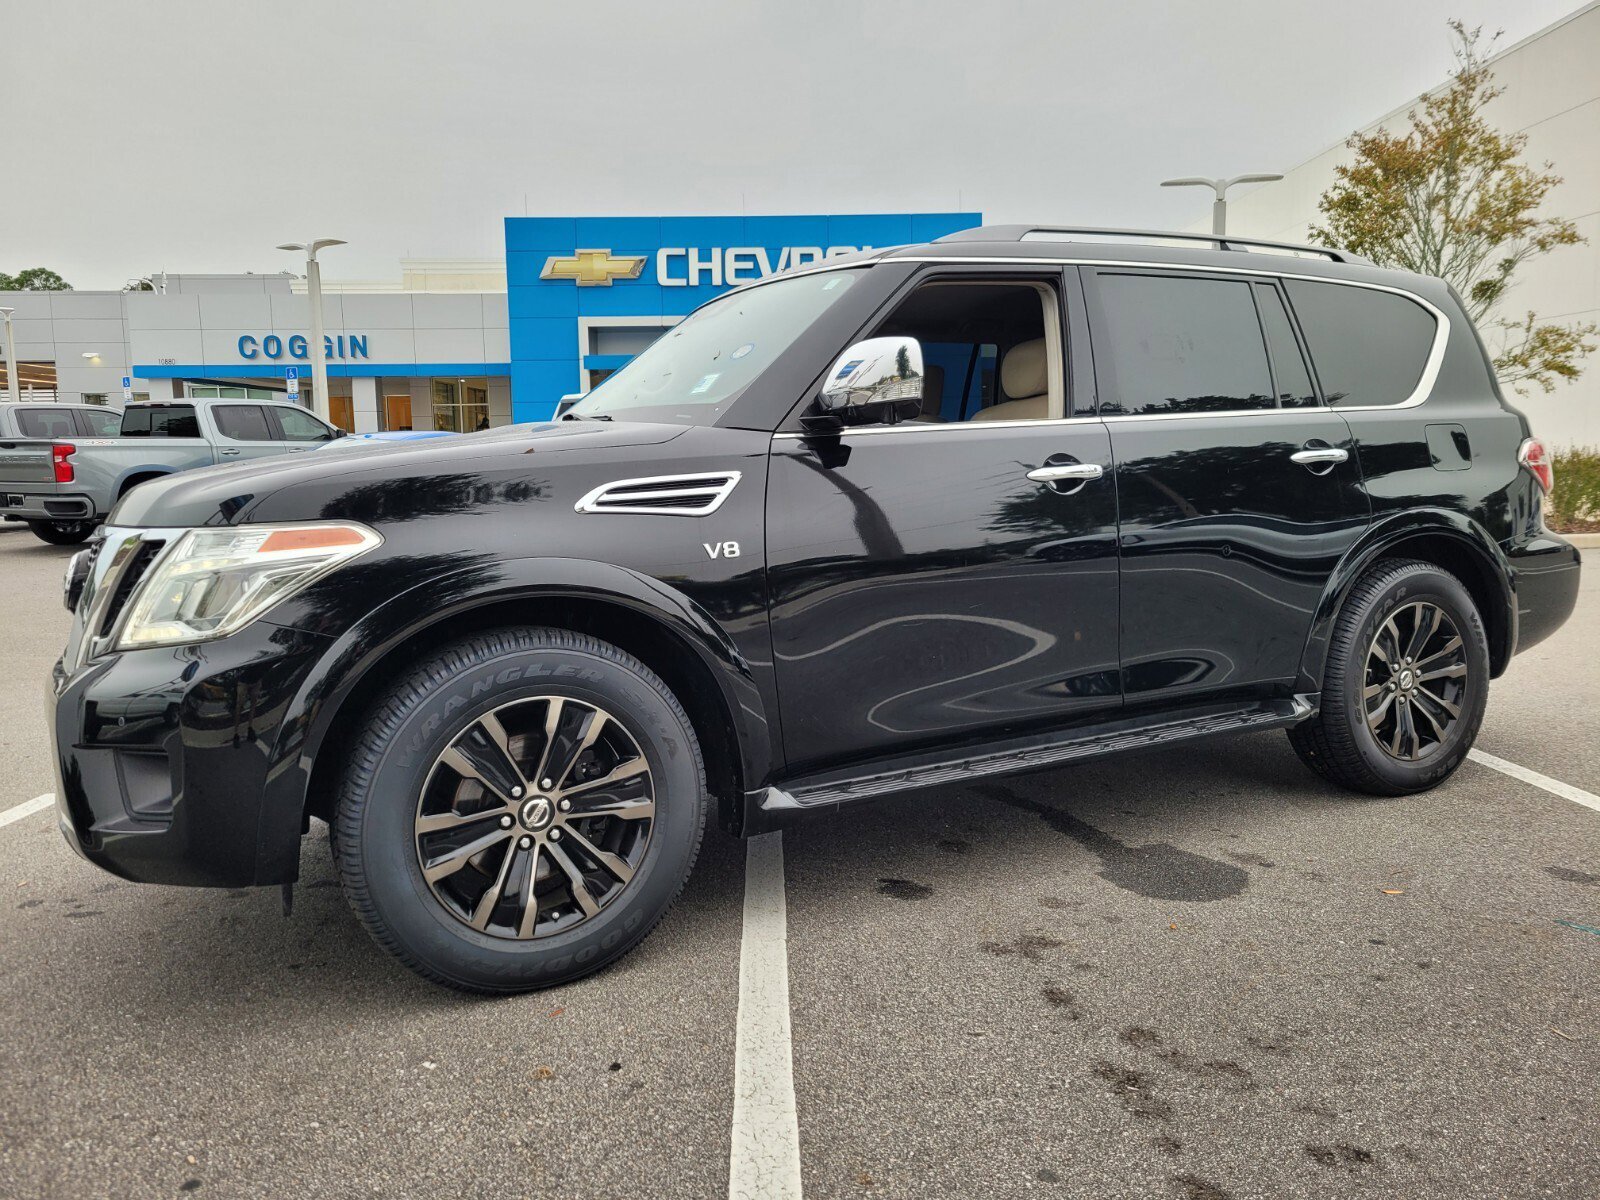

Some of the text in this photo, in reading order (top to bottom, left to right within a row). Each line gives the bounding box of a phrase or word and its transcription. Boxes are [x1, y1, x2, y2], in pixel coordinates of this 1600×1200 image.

[656, 245, 872, 287] CHEV
[702, 541, 740, 559] V8
[396, 663, 605, 768] WRANGLER
